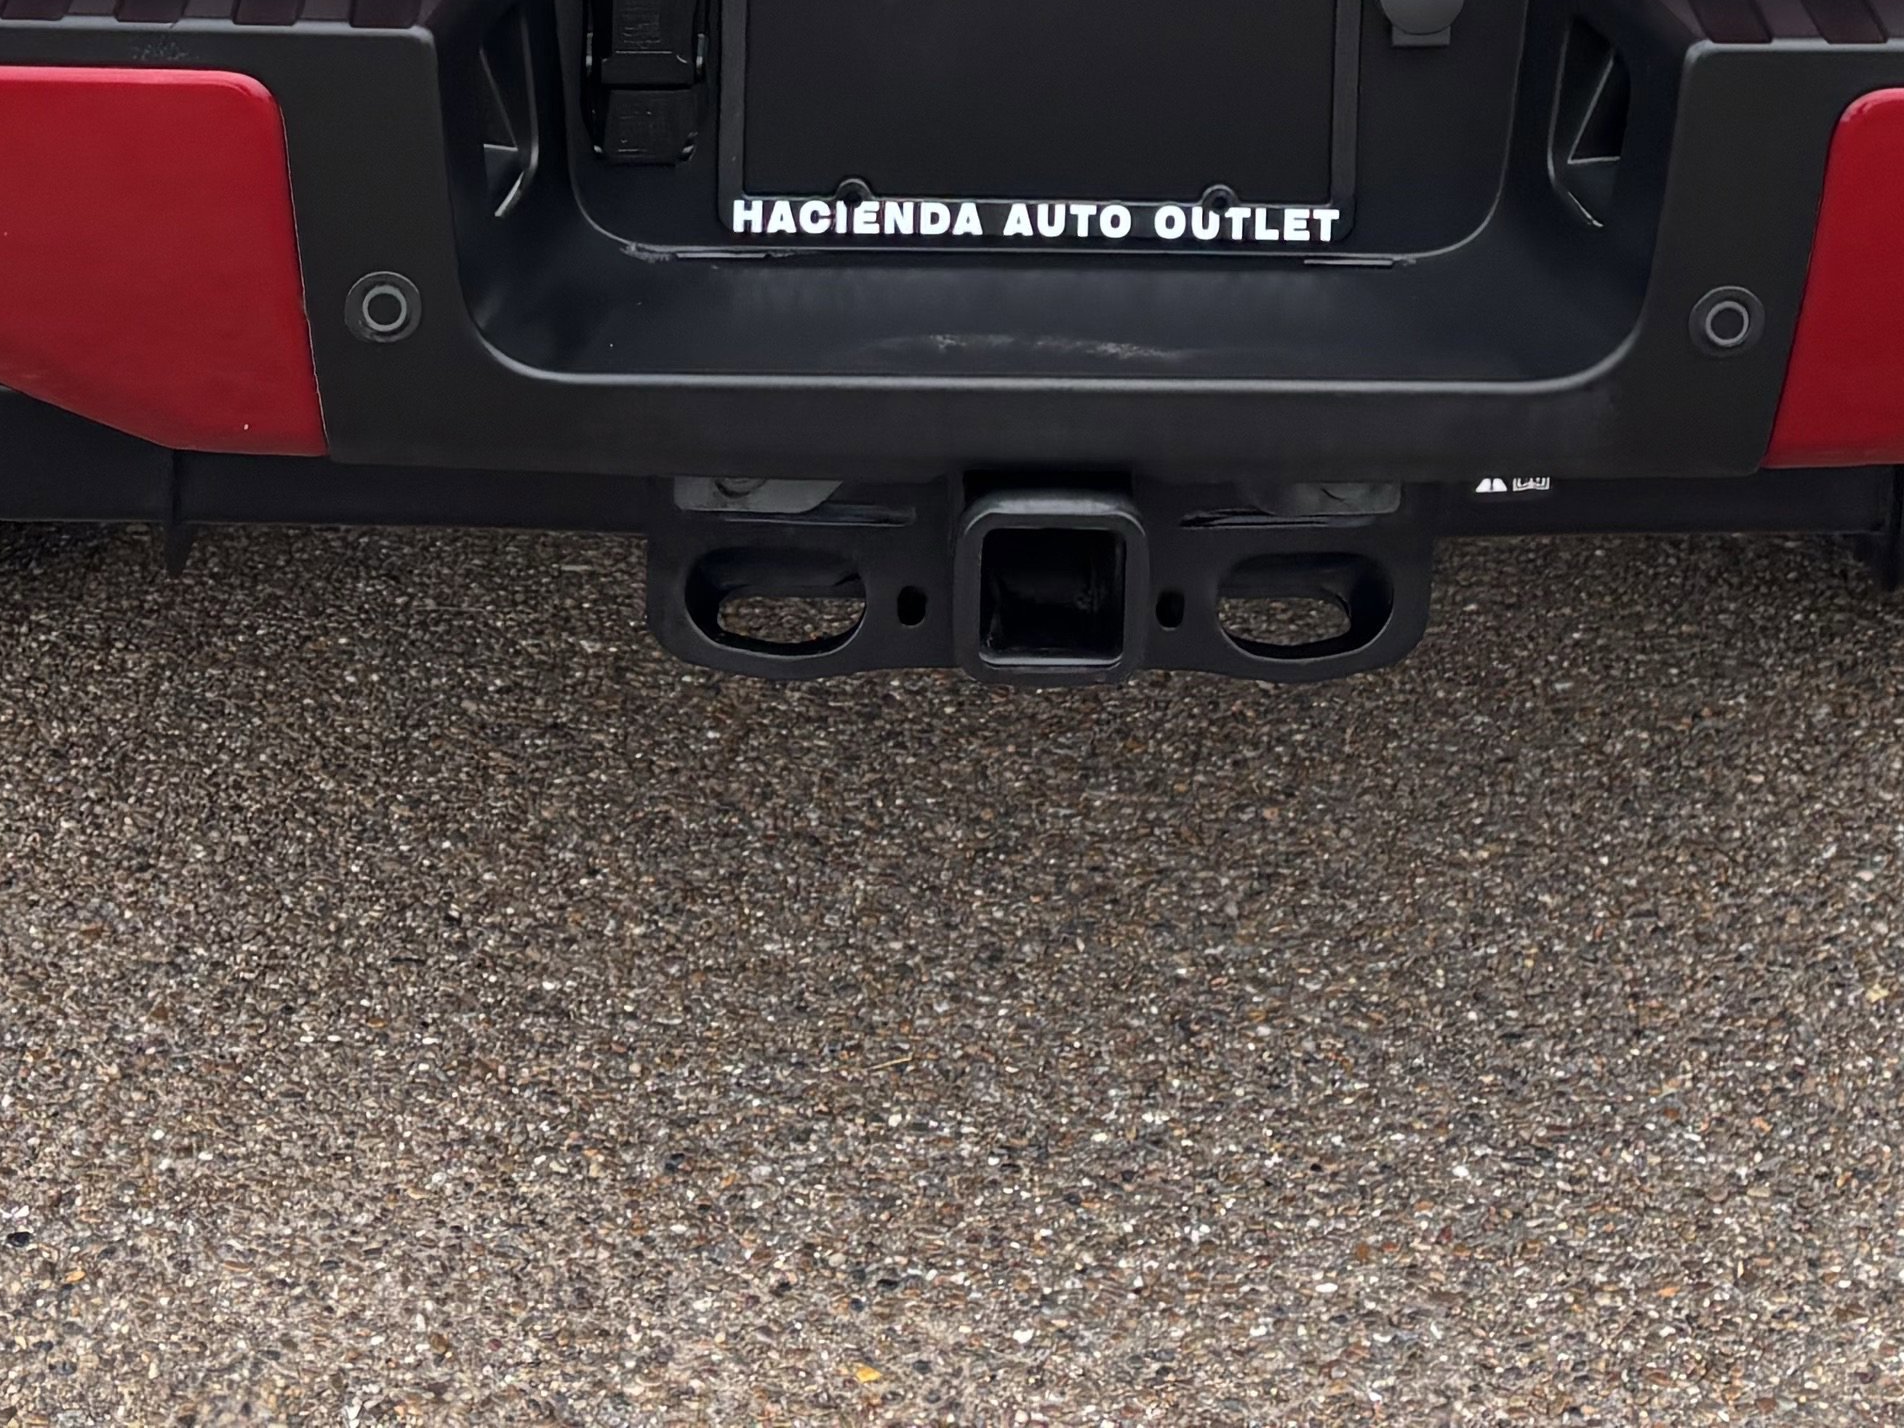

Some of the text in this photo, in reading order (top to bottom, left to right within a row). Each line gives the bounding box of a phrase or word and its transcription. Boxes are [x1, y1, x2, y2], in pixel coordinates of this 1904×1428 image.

[732, 200, 1341, 243] HACIENDA AUTO OUTLET
